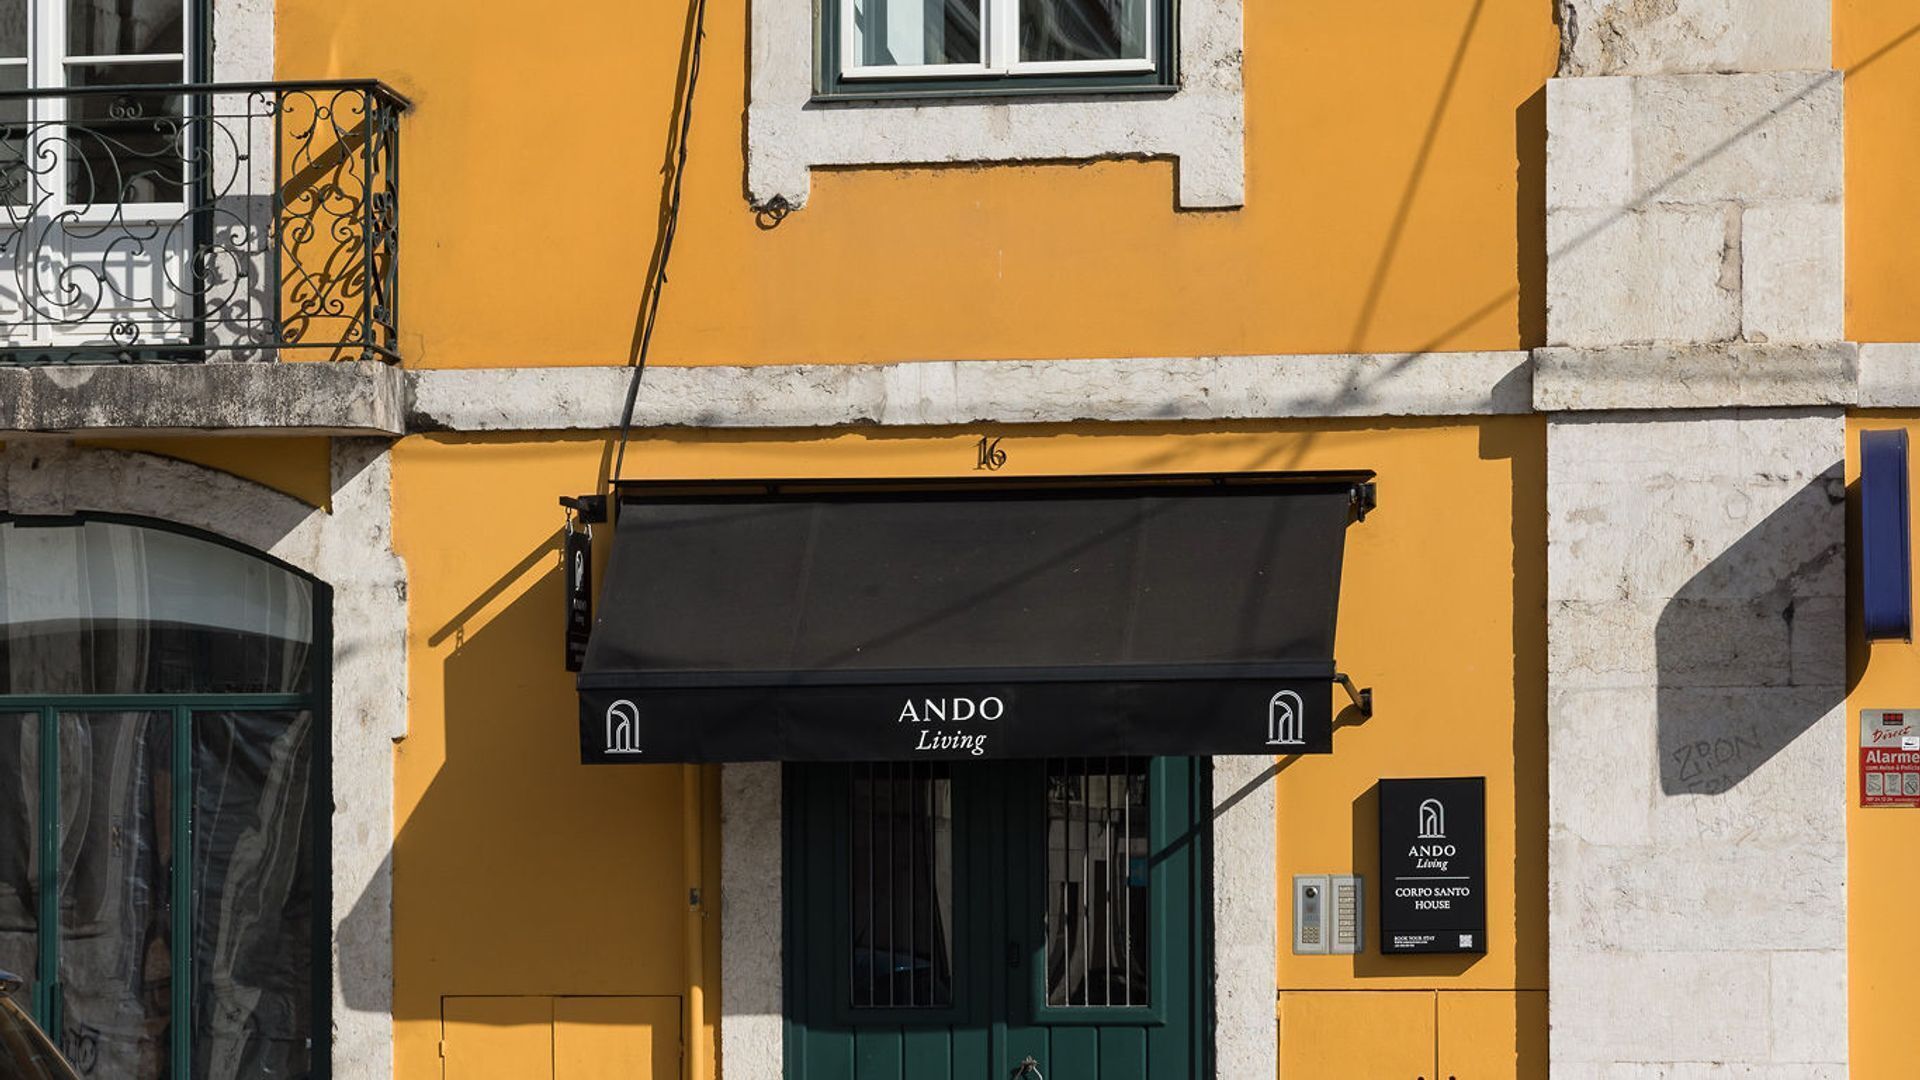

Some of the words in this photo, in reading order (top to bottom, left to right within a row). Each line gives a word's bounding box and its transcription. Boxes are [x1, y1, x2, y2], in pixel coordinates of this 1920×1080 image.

[974, 435, 1006, 470] 16
[898, 697, 1004, 722] ANDO
[1872, 725, 1911, 743] Direct
[915, 730, 987, 755] Living
[1866, 750, 1920, 763] Alarme
[1408, 845, 1456, 857] ANDO
[1416, 859, 1449, 871] Living
[1395, 887, 1433, 897] CORPO
[1433, 886, 1470, 896] SANTO
[1415, 900, 1451, 909] HOUSE
